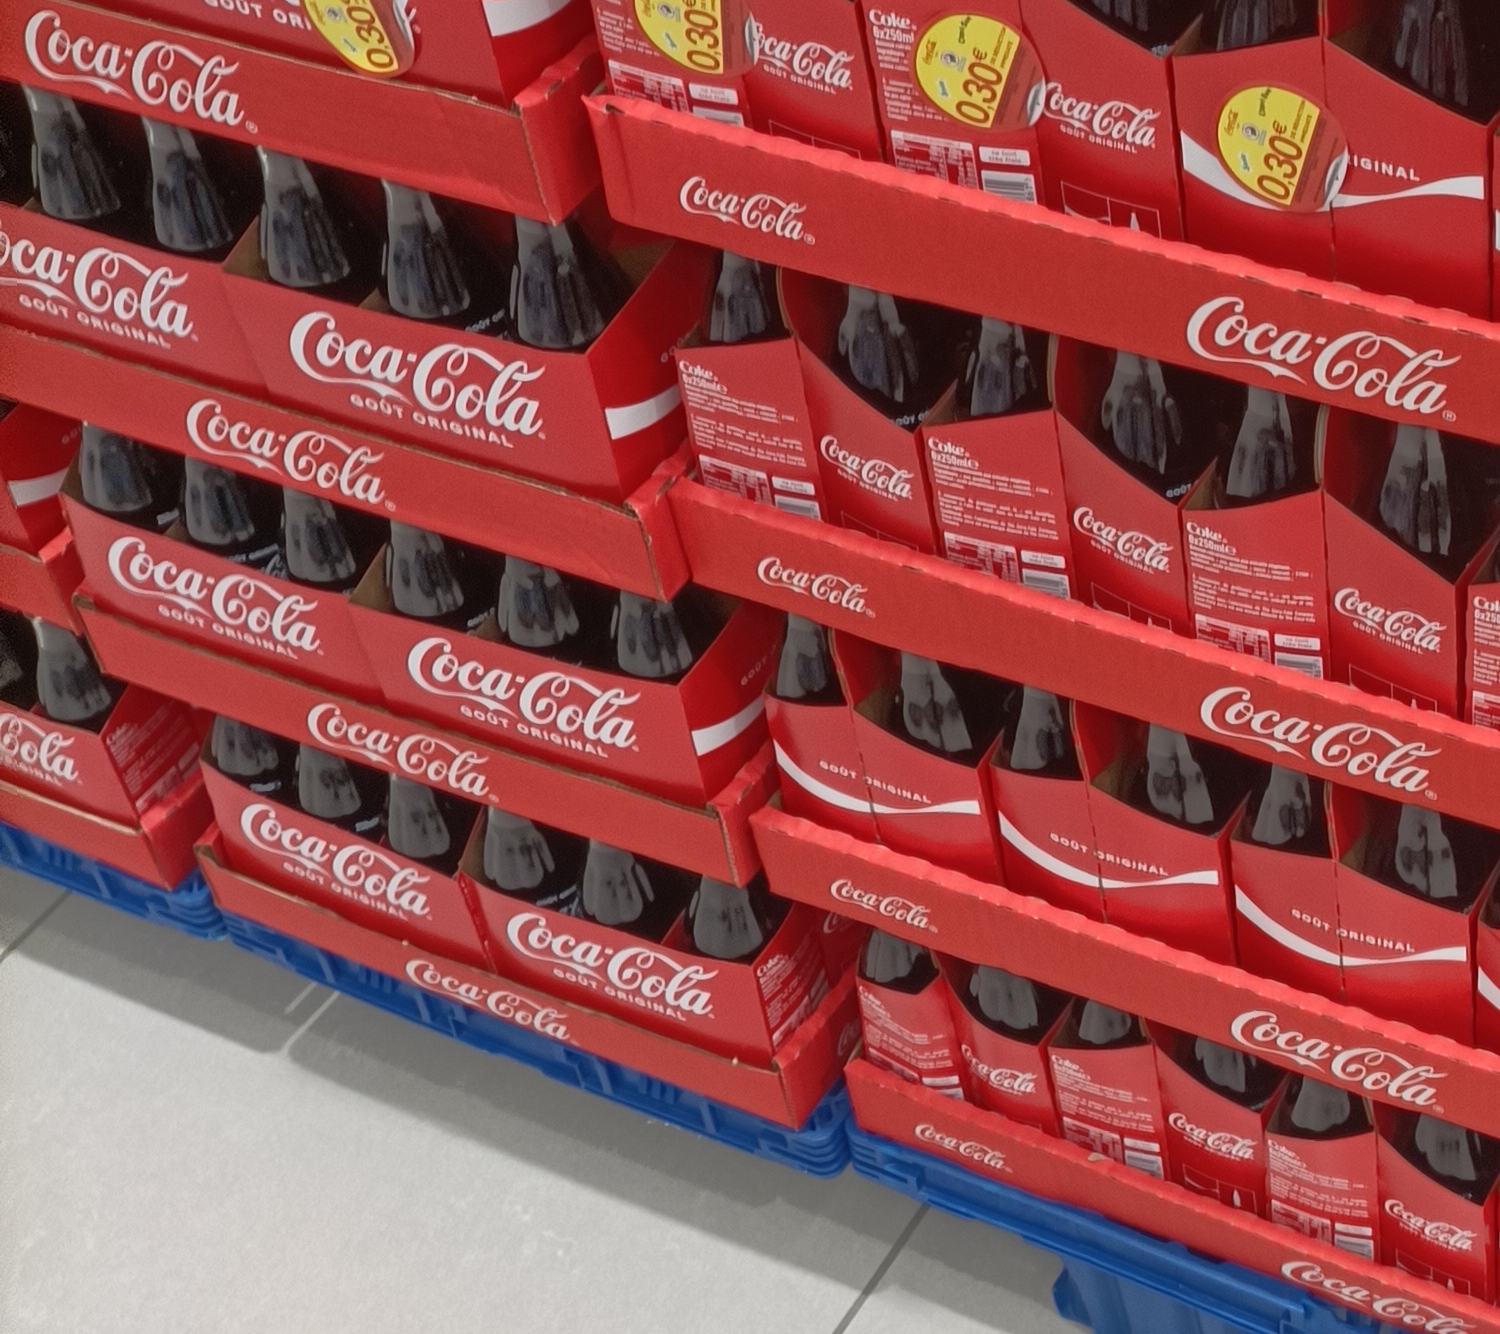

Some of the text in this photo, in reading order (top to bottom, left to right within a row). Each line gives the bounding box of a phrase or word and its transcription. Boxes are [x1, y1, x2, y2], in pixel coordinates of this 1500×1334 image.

[868, 8, 912, 30] Coke
[23, 9, 245, 128] Coca-Cola
[791, 72, 837, 95] ORIGINAL
[1088, 130, 1138, 155] ORIGINAL
[678, 175, 808, 243] Coca-Cola
[18, 294, 172, 351] GOÛT ORIGINAL
[289, 310, 547, 435] Coca-Cola
[679, 359, 715, 382] Coke
[1186, 296, 1462, 415] Coca-Cola
[349, 392, 516, 450] GOÛT ORIGINAL
[928, 436, 966, 457] Coke
[186, 398, 387, 506] Coca-Cola
[820, 434, 914, 499] Coca-Cola
[1073, 506, 1174, 574] Coca-Cola
[1186, 520, 1223, 543] Coke
[107, 536, 321, 653] Coca-Cola
[757, 556, 869, 615] Coca-Cola
[157, 603, 299, 661] GOÛT ORIGINAL
[1334, 586, 1448, 653] Coca-Cola
[407, 636, 642, 751] Coca-Cola
[306, 702, 491, 799] Coca-Cola
[459, 704, 609, 759] GOÛT ORIGINAL
[1200, 686, 1443, 794] Coca-Cola
[818, 758, 932, 806] GOÛT ORIGINAL
[240, 803, 431, 919] Coca-Cola
[1049, 831, 1169, 877] GOÛT ORIGINAL
[829, 878, 932, 932] Coca-Cola
[1291, 907, 1417, 955] GOÛT ORIGINAL
[506, 912, 719, 1019] Coca-Cola
[552, 966, 687, 1022] GOÛT ORIGINAL
[405, 957, 573, 1043] Coca-Cola
[961, 1043, 1039, 1095] Coca-Cola
[1230, 1009, 1449, 1108] Coca-Cola
[914, 1123, 1007, 1170] Coca-Cola
[1168, 1111, 1259, 1161] Coca-Cola
[1384, 1198, 1478, 1251] Coca-Cola
